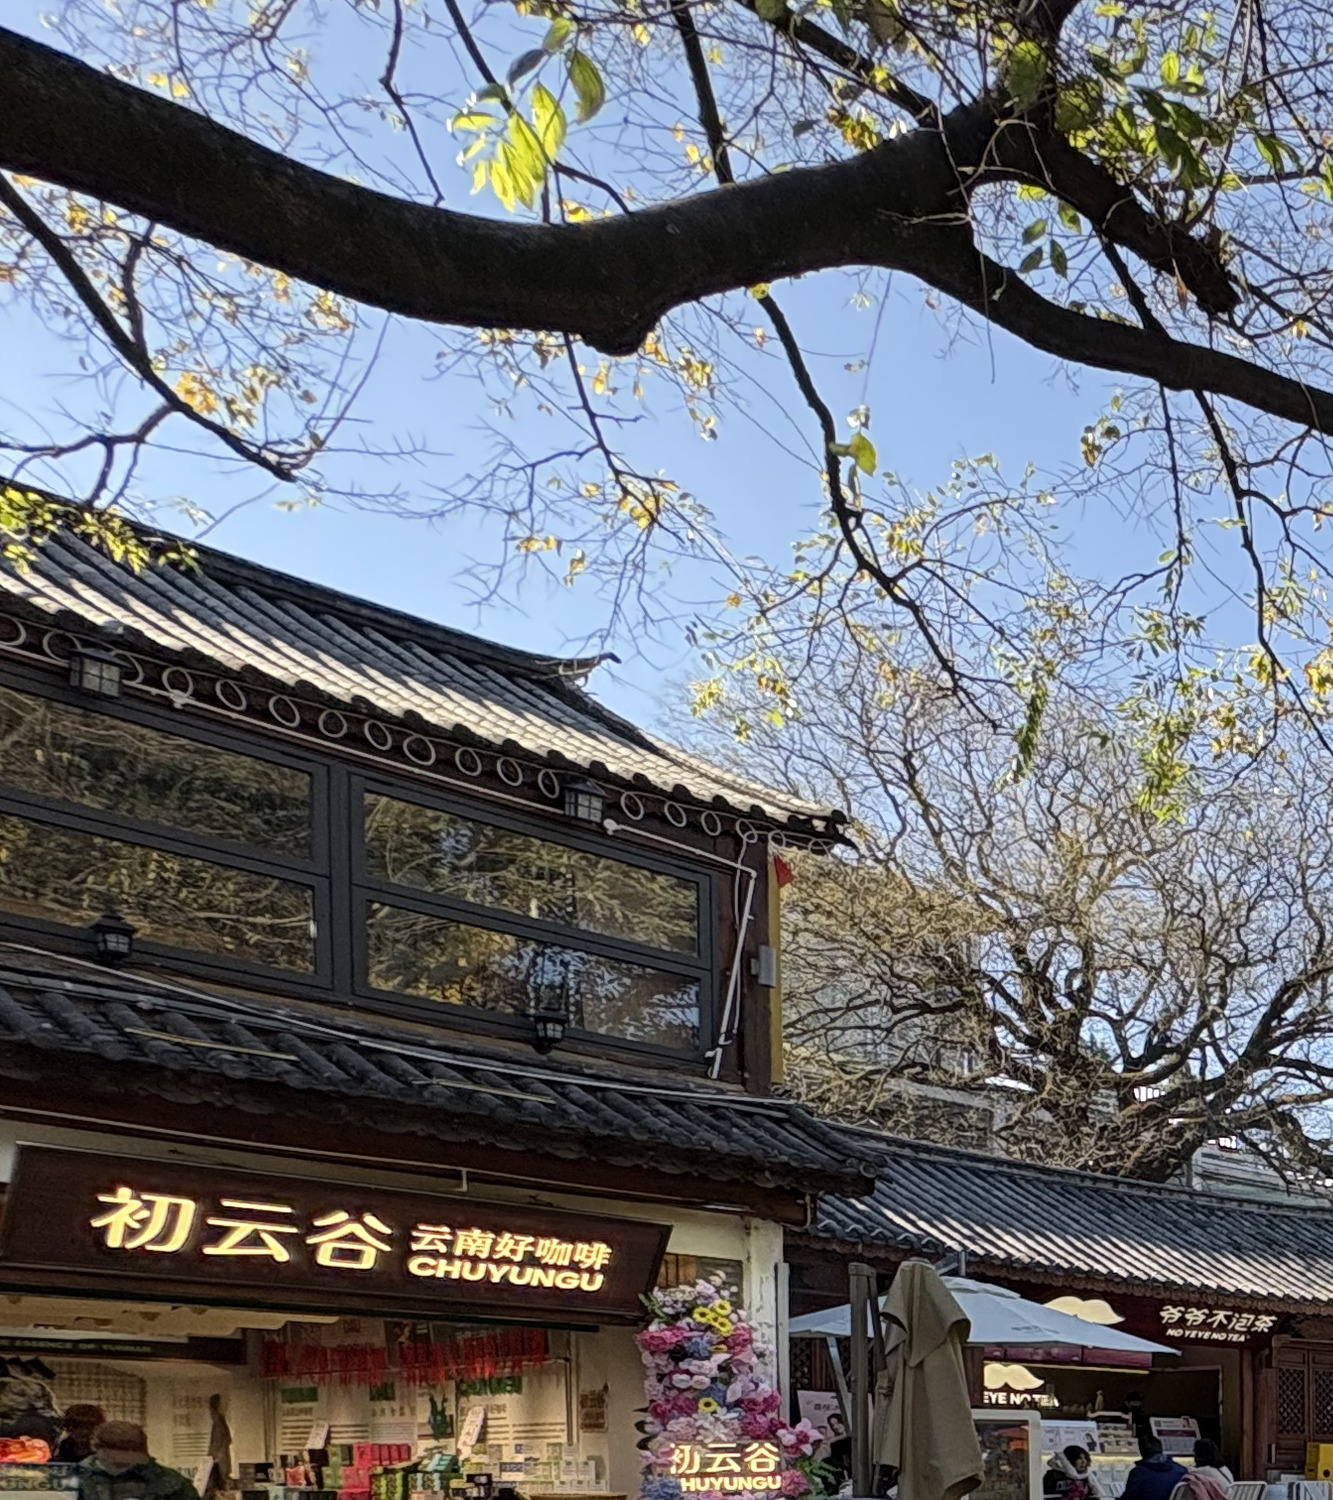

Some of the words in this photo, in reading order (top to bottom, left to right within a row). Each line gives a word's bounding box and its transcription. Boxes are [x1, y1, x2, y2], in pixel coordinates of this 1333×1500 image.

[89, 1186, 392, 1270] 初云谷
[410, 1223, 612, 1270] 云南好咖啡
[408, 1257, 604, 1292] CHUYUNGU
[1160, 1305, 1278, 1333] 爷爷不泡茶
